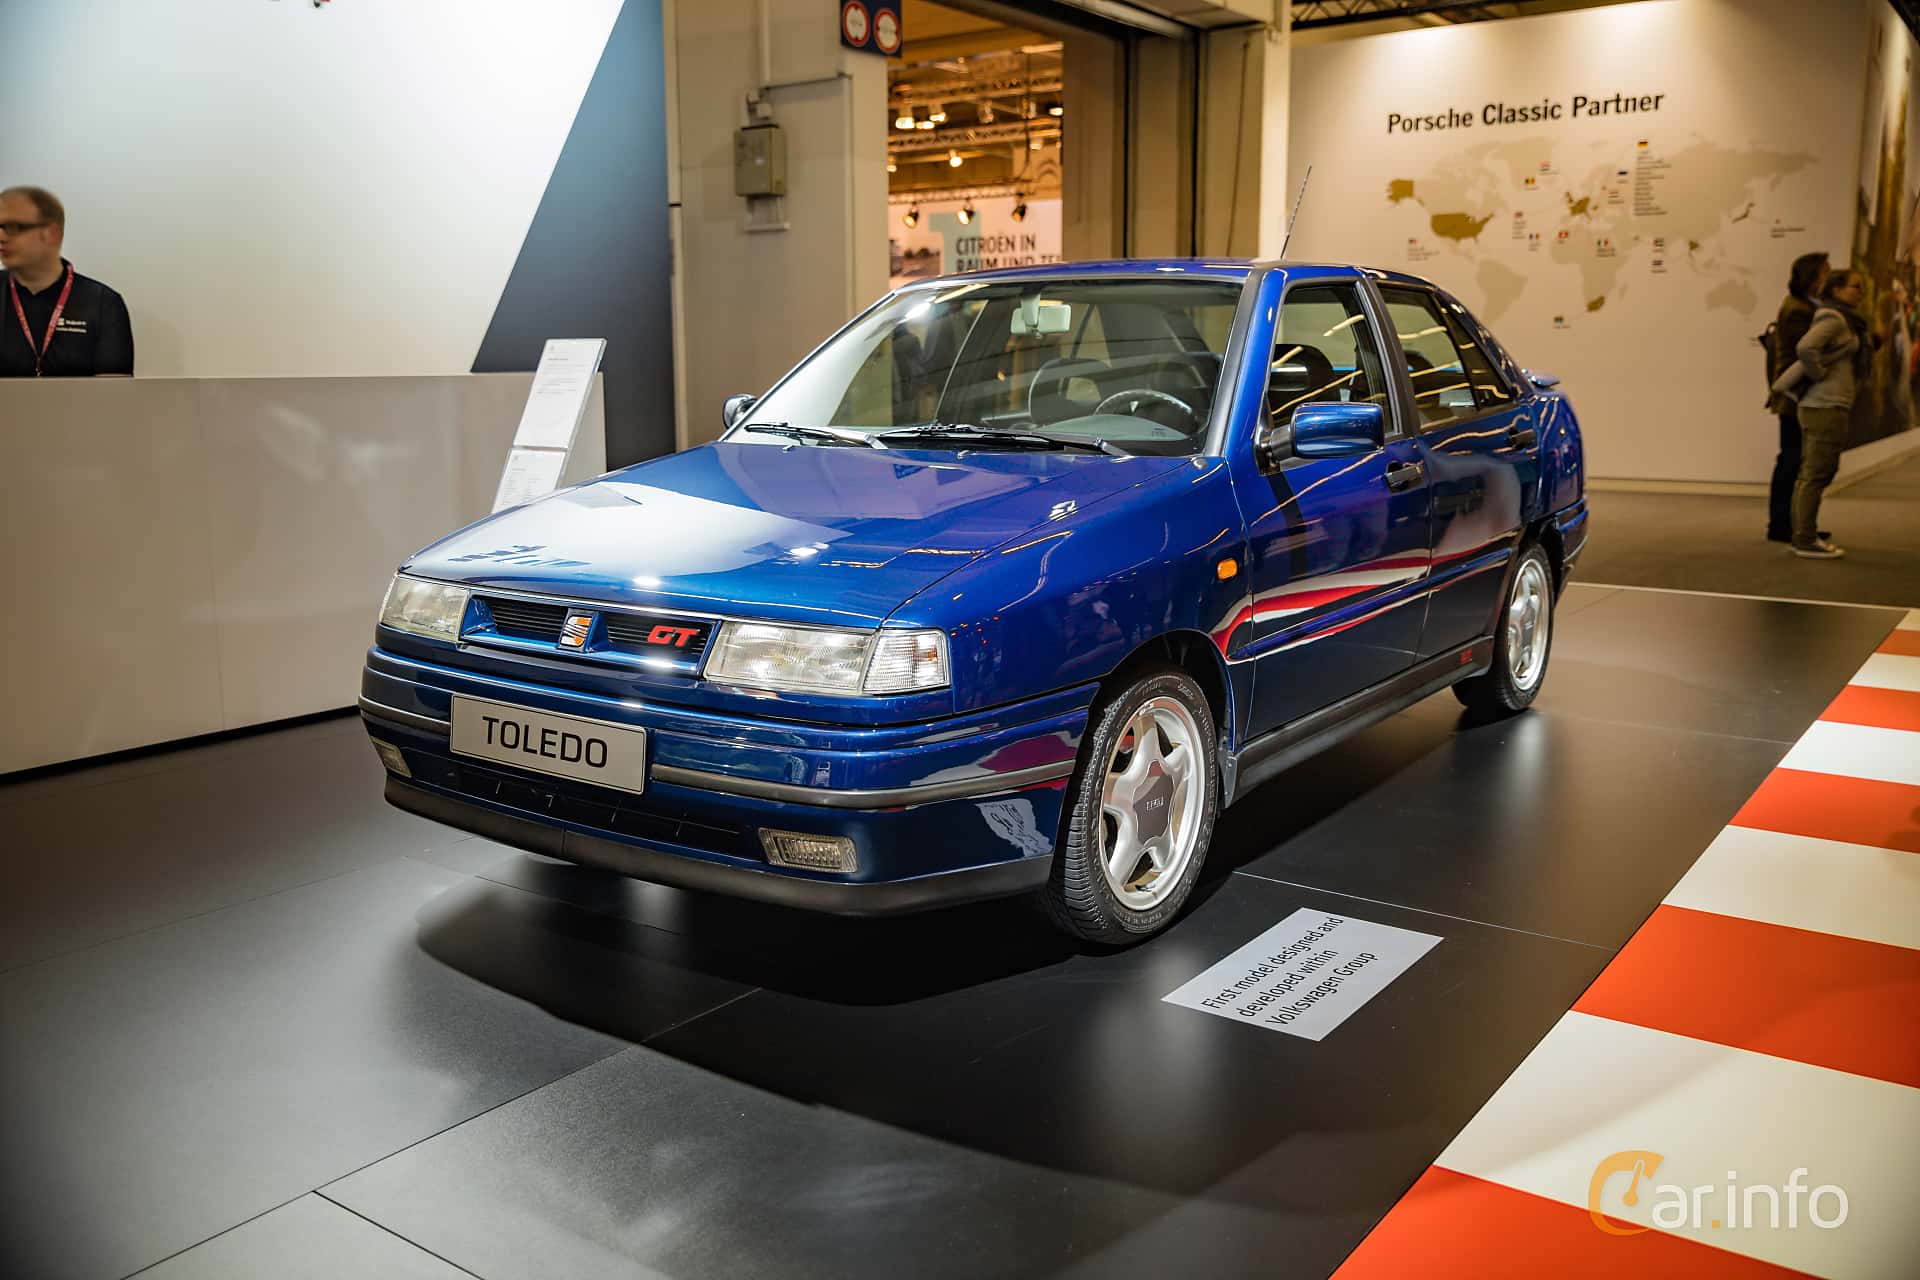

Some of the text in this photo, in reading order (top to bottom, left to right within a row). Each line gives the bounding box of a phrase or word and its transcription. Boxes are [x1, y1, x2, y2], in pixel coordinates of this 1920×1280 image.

[1387, 92, 1665, 134] Porsche Classic Partner
[1020, 233, 1036, 251] IN
[647, 624, 698, 648] GT
[482, 716, 608, 768] TOLEDO
[1201, 916, 1344, 1009] First model designed and
[1236, 949, 1339, 1018] developed within
[1265, 951, 1379, 1026] Volkswagen Group
